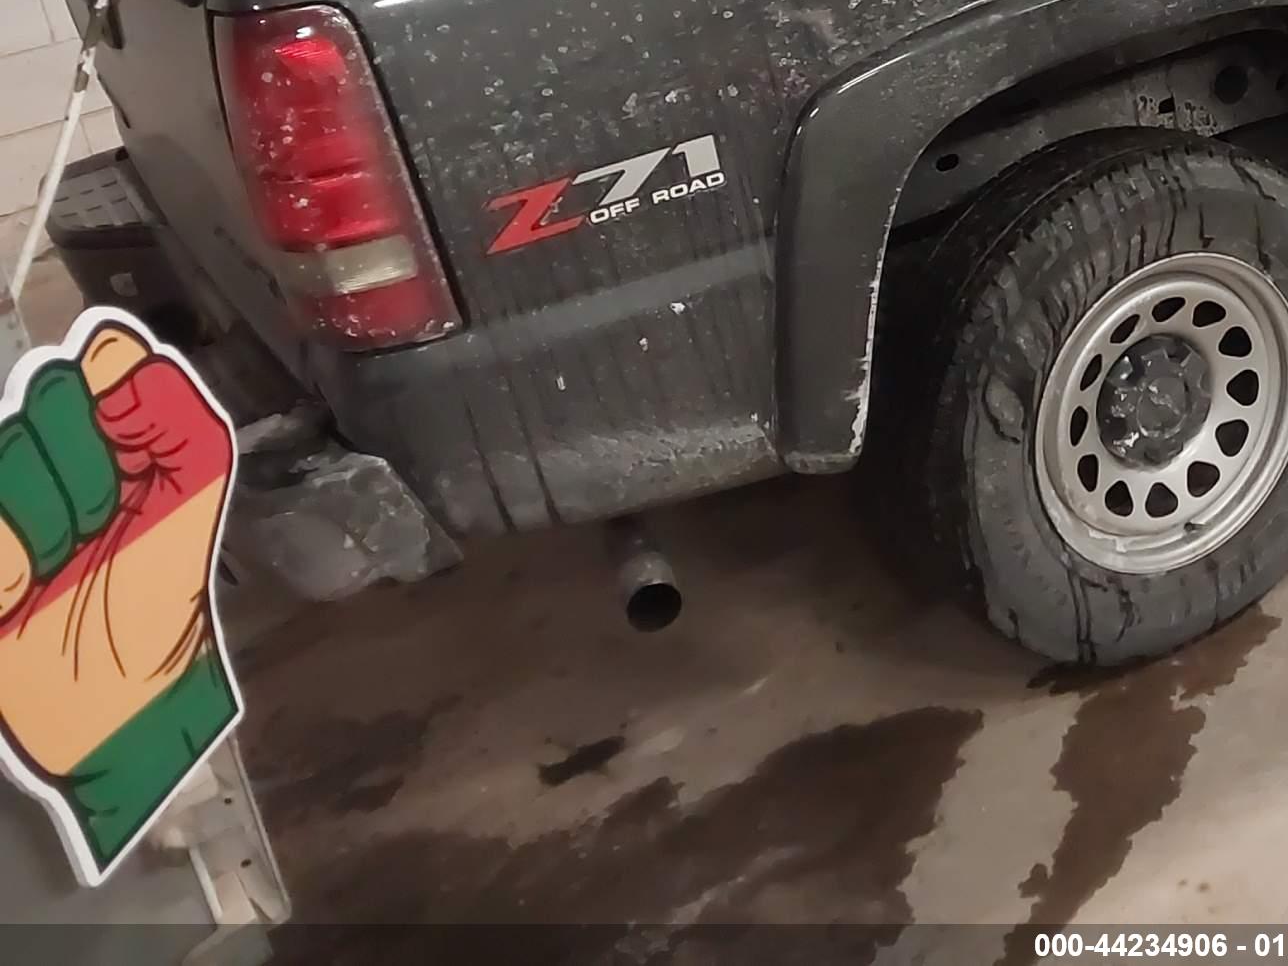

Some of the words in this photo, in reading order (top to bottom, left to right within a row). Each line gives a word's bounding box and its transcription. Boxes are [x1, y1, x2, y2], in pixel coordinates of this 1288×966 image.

[484, 134, 721, 255] Z71
[589, 198, 641, 225] OFF
[651, 172, 726, 204] ROAD
